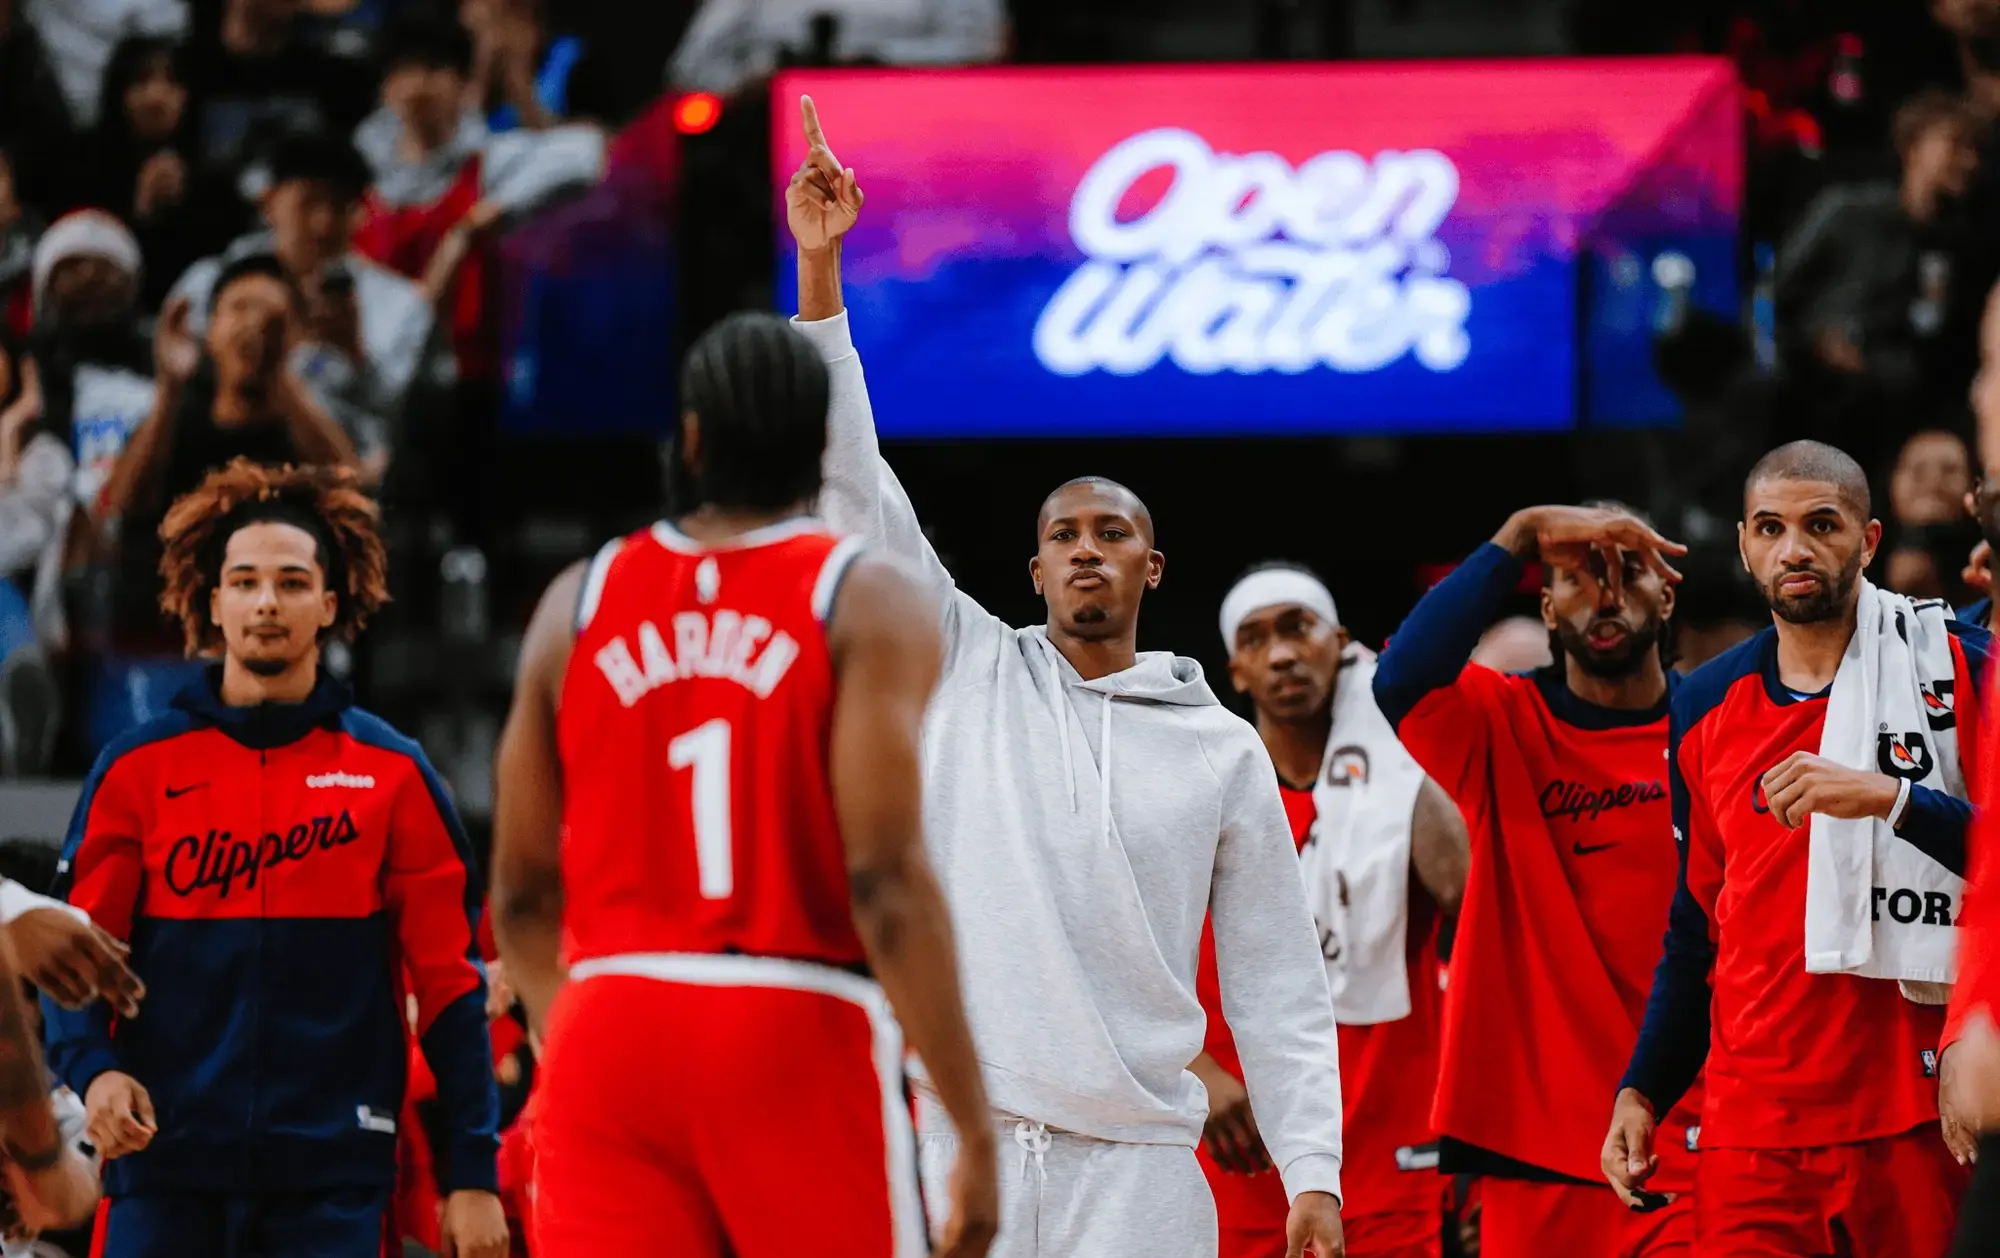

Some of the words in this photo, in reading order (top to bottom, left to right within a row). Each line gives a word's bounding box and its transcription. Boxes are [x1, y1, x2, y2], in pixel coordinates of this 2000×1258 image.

[1069, 126, 1460, 261] Open
[1032, 246, 1472, 377] Water
[594, 609, 800, 708] HARDEN
[165, 809, 360, 898] Clippers
[668, 717, 733, 900] 1
[1540, 780, 1666, 823] Clippers
